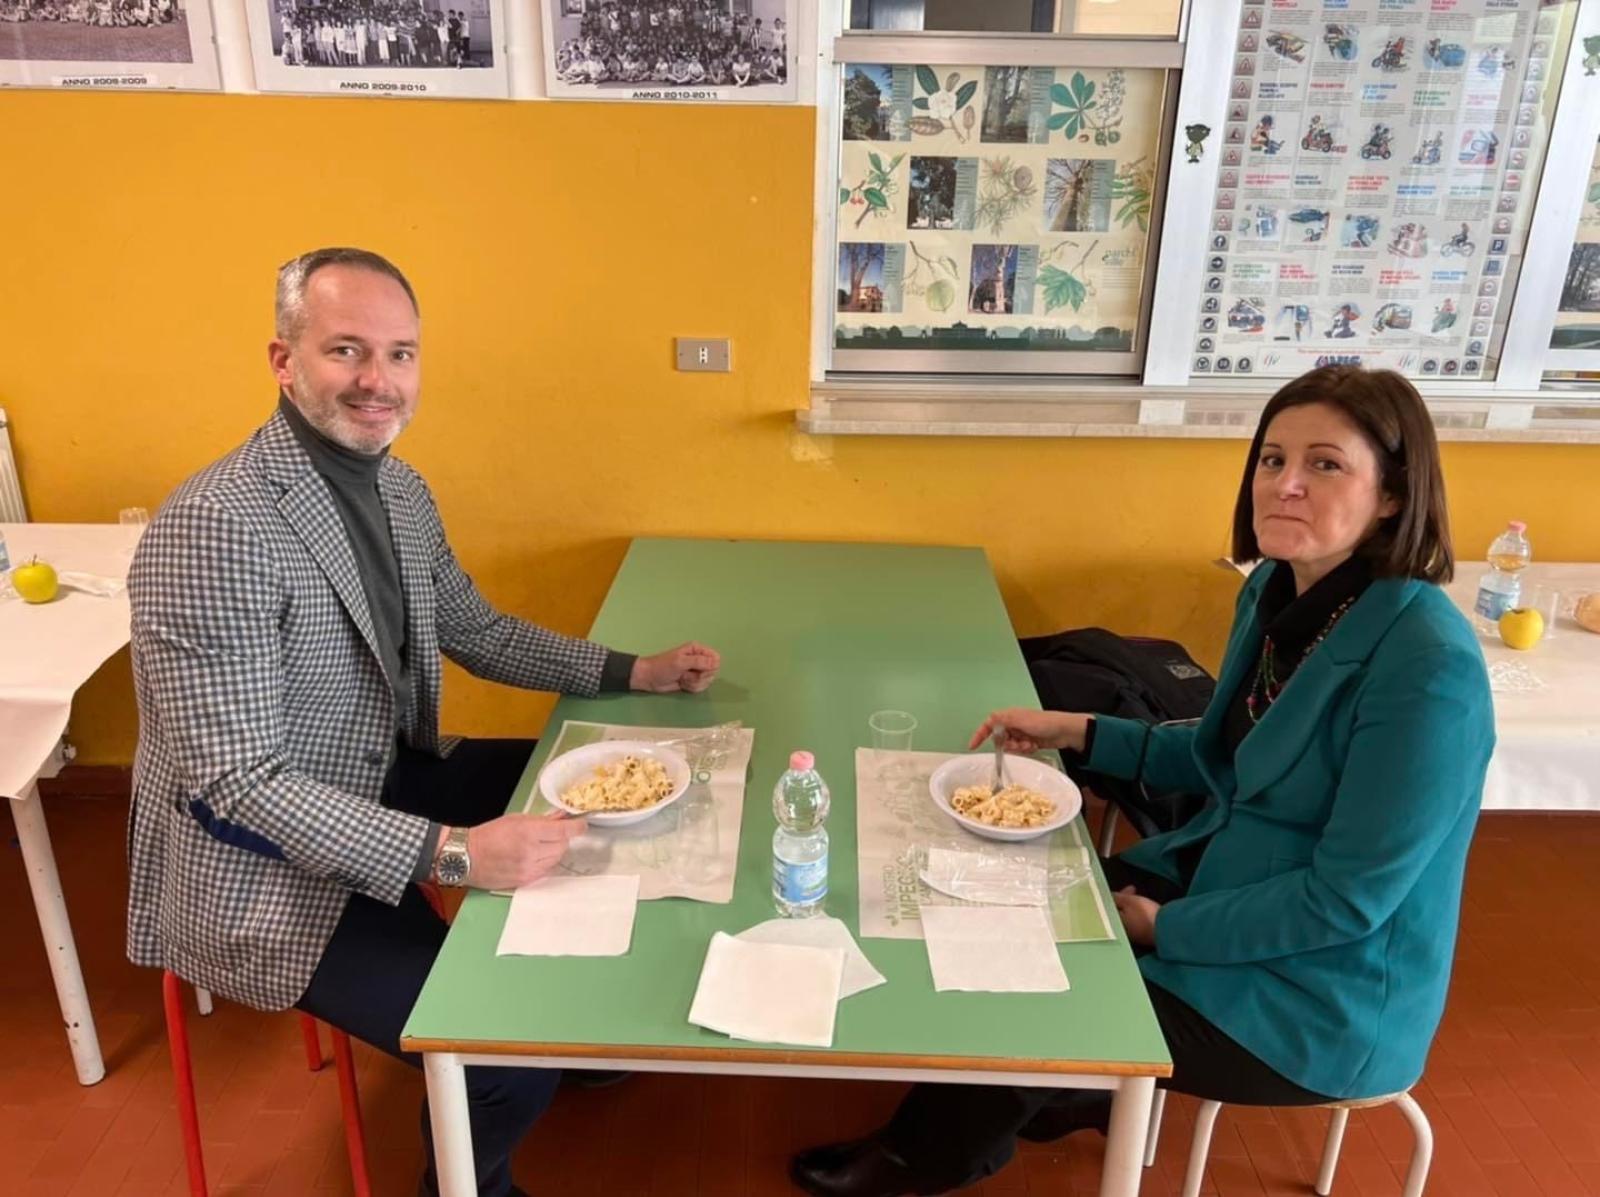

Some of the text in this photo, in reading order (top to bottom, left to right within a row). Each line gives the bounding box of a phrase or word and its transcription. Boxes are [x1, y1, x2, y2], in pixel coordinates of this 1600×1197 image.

[62, 78, 91, 86] ANNO
[339, 82, 427, 92] ANNO 2009-2010
[632, 91, 718, 100] ANNO 2010-2011
